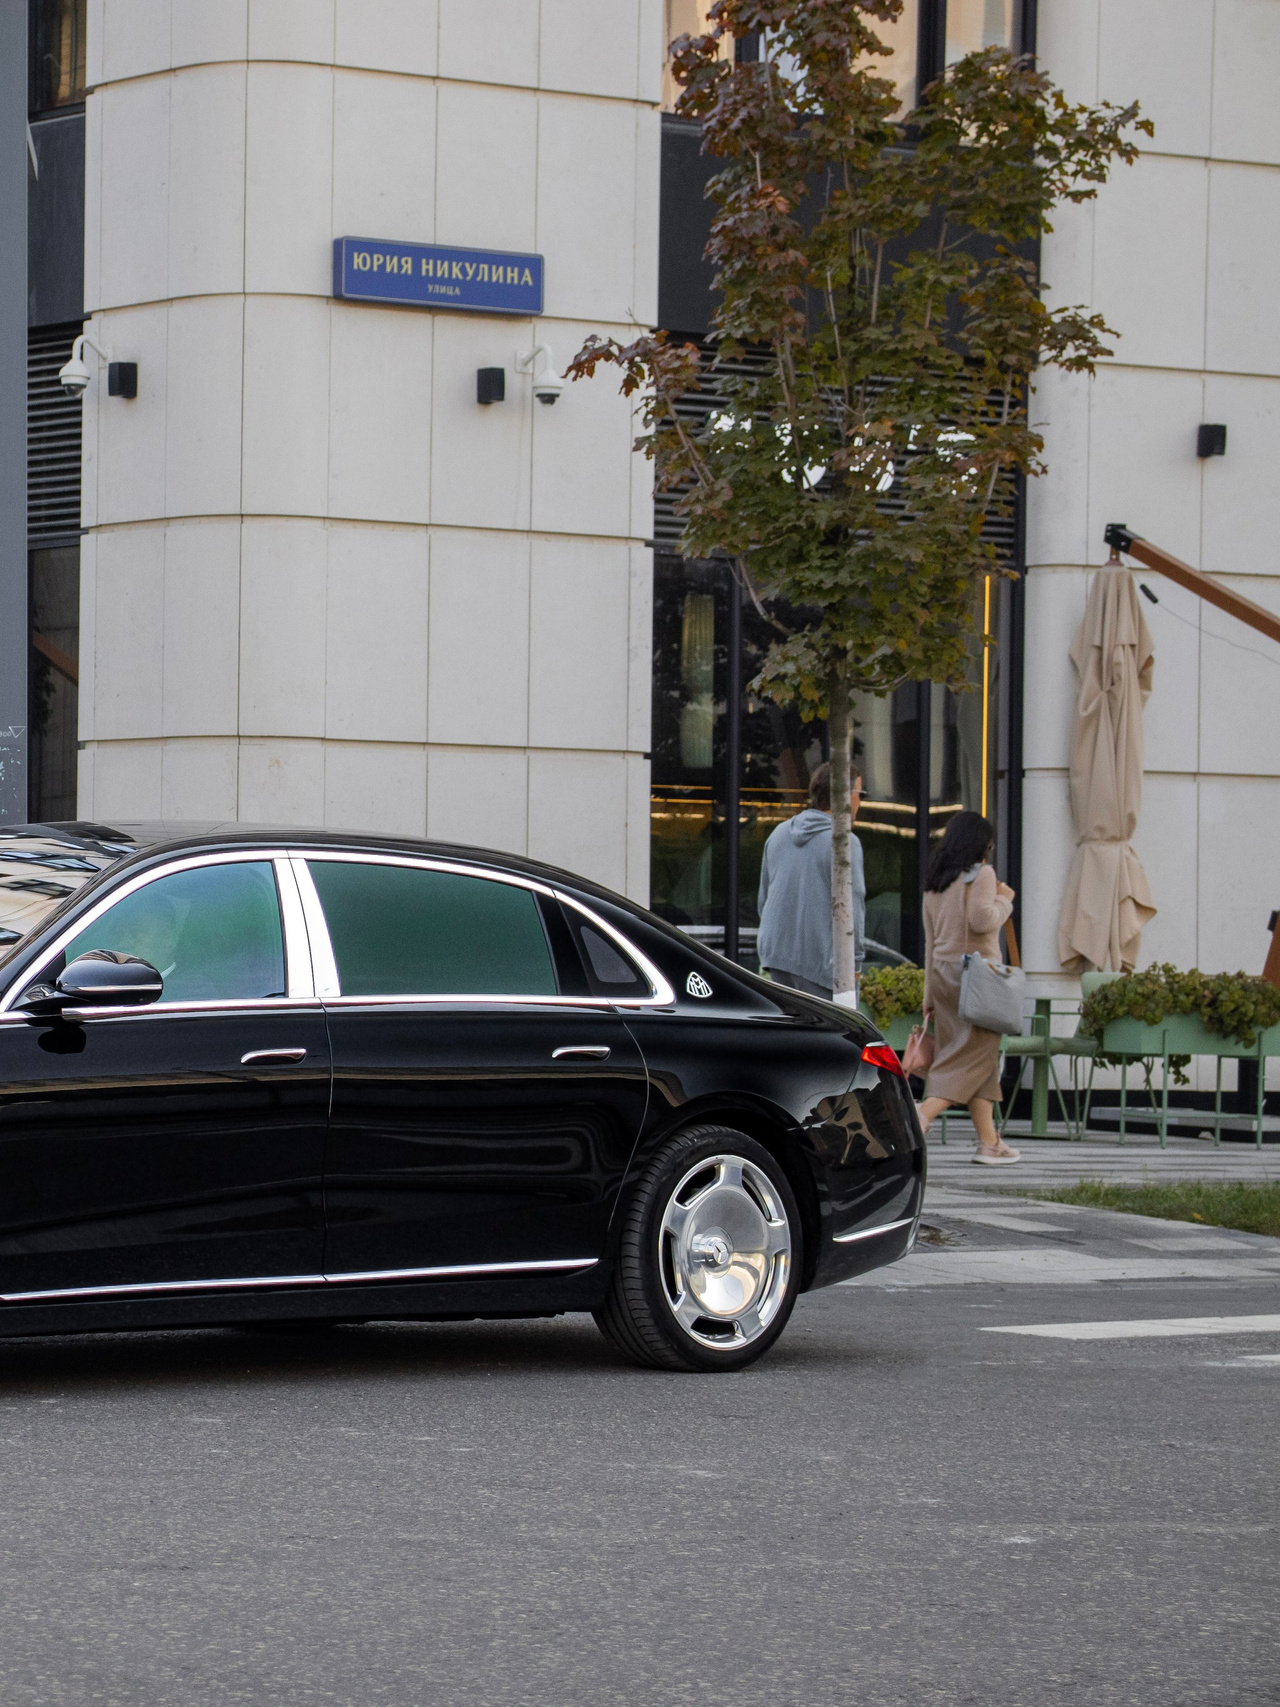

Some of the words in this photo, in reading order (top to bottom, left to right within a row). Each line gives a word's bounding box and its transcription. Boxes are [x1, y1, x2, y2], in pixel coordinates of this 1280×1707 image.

[353, 251, 412, 276] ЮРИЯ
[421, 258, 534, 287] НИКУЛИНА
[427, 284, 461, 296] УЛИЦА
